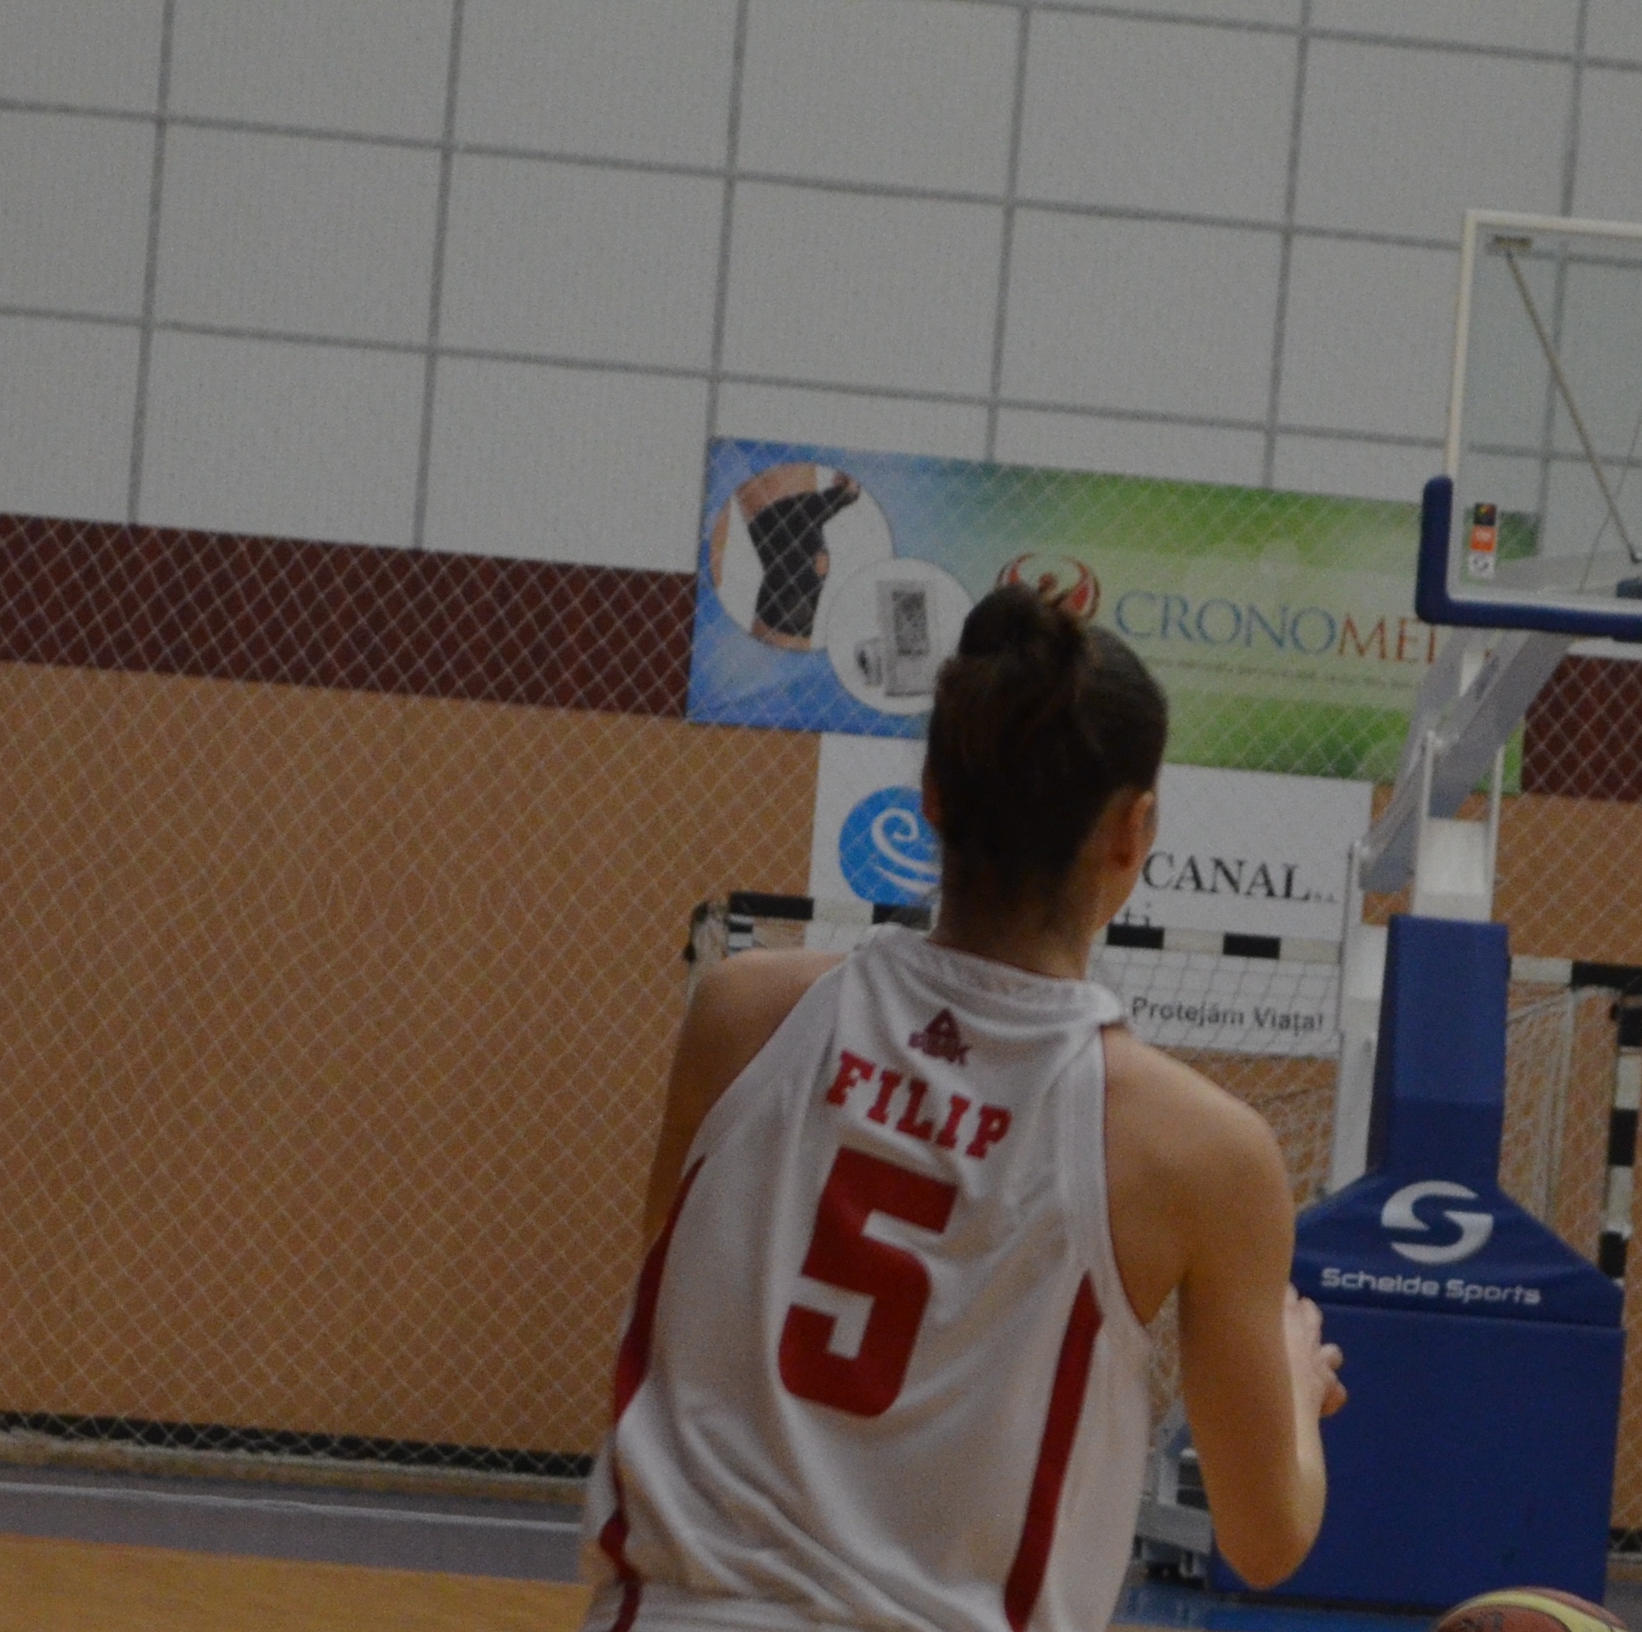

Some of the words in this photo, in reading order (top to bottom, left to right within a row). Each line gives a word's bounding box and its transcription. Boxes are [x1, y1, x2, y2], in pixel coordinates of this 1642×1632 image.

[826, 1048, 1012, 1159] FILIP
[778, 1146, 959, 1418] 5
[1320, 1267, 1440, 1298] Schelde
[1445, 1278, 1541, 1306] Sports
